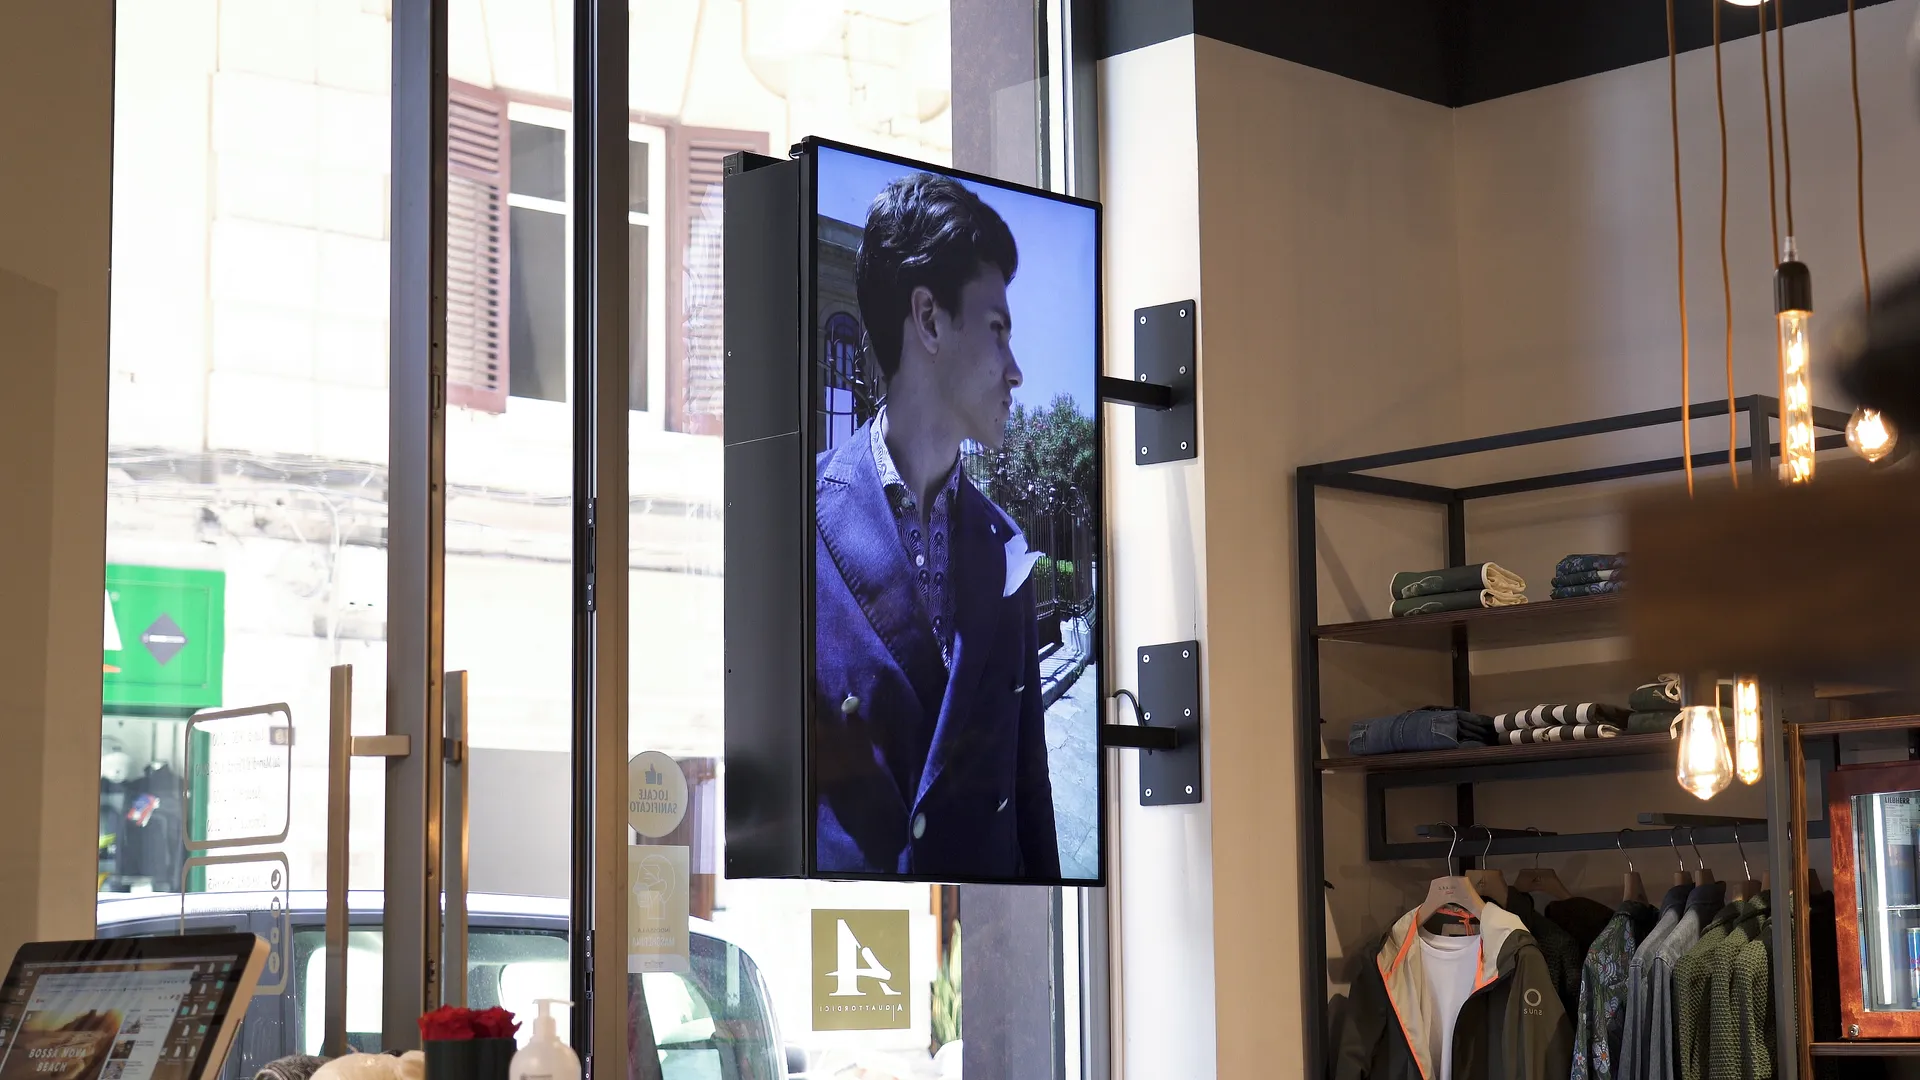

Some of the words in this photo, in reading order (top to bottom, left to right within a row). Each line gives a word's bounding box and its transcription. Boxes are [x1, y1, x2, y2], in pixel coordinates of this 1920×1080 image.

[28, 1047, 59, 1058] BOSSA
[60, 1047, 87, 1058] NOVA
[36, 1061, 68, 1072] BEACH
